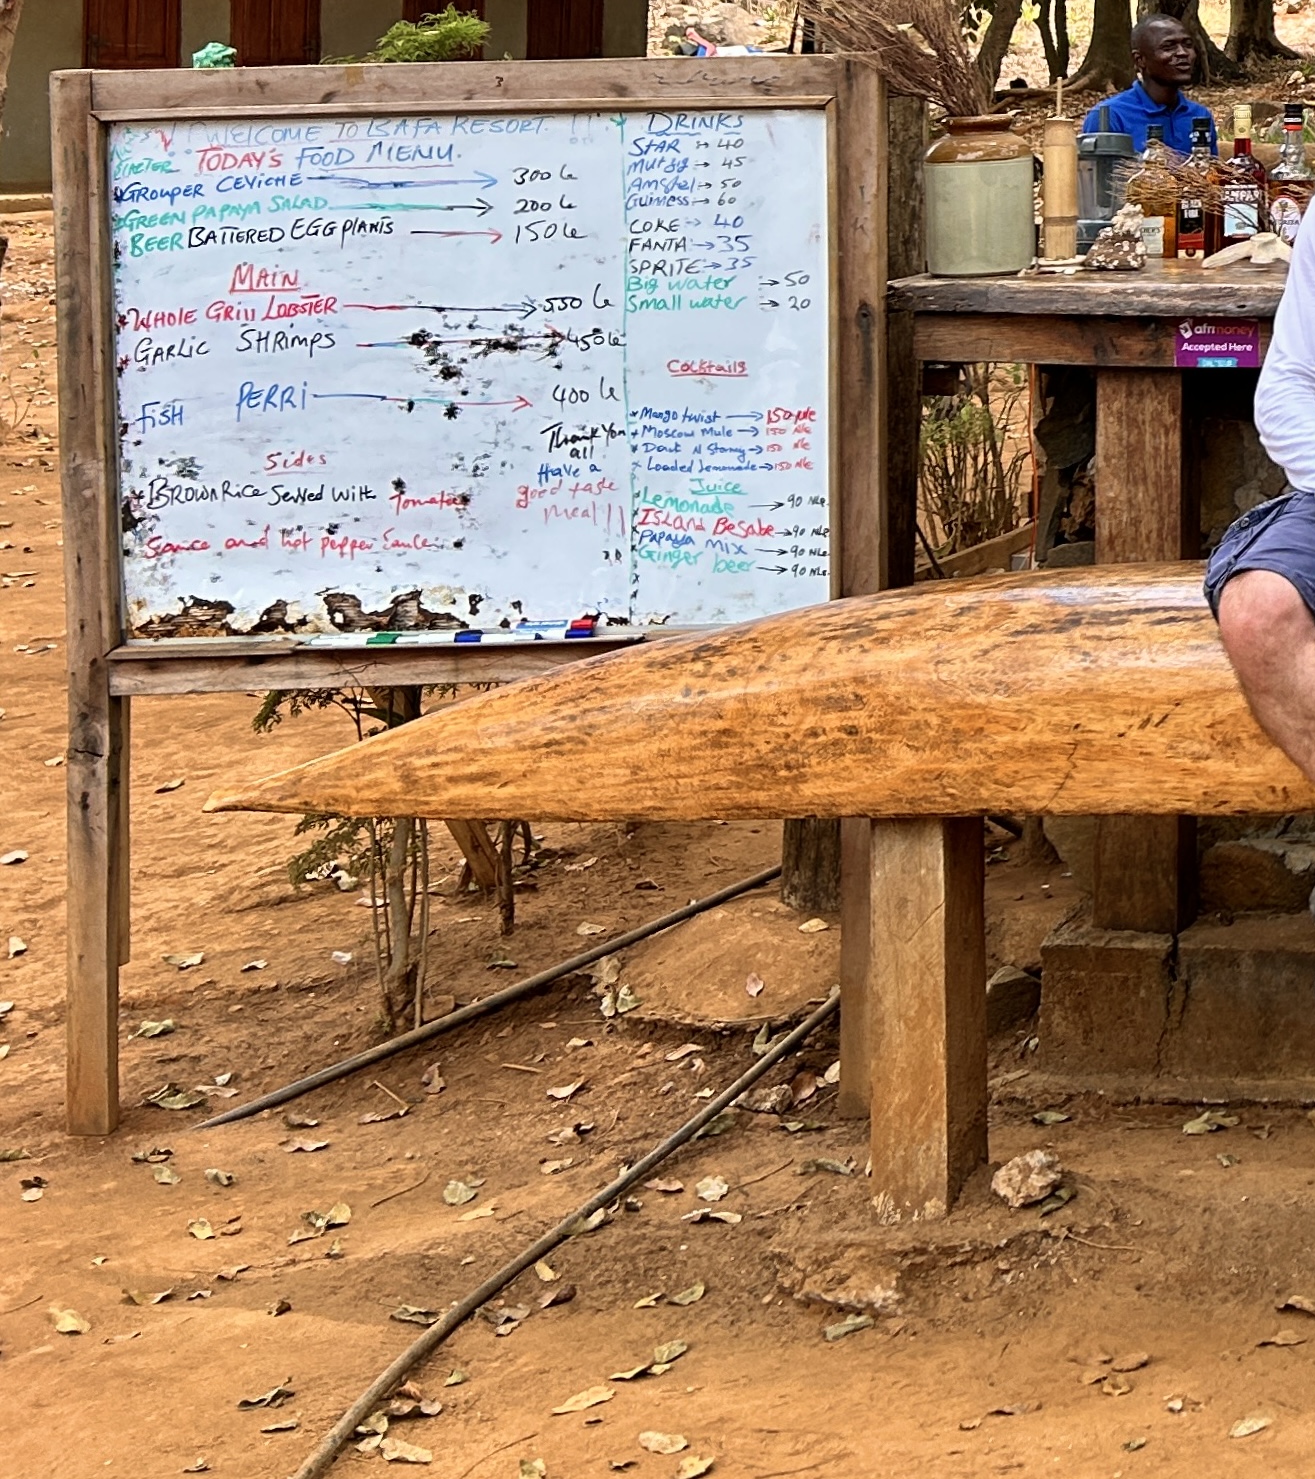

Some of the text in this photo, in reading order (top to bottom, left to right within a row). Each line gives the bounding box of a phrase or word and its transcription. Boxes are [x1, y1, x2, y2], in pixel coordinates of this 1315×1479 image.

[334, 122, 358, 139] TO
[647, 112, 745, 133] DRINKS
[716, 138, 745, 150] 40
[296, 147, 356, 167] FOOD
[721, 155, 748, 169] 45
[513, 167, 551, 186] 300
[720, 178, 742, 189] 50
[717, 192, 737, 206] 60
[122, 209, 186, 232] GREEN
[267, 195, 329, 212] SALAD
[513, 198, 551, 215] 200
[629, 214, 745, 235] COKE 40
[129, 231, 184, 258] BEER
[187, 225, 285, 249] BATTERED
[515, 219, 558, 244] 150
[628, 234, 754, 254] FANTA 35
[628, 256, 758, 277] SPRITE 35
[626, 270, 811, 294] Big water 50
[261, 294, 338, 322] LOBSTER
[541, 296, 582, 314] 550
[625, 294, 812, 314] Small water 20
[566, 329, 605, 352] 450
[1194, 323, 1256, 339] afrimoney
[1181, 342, 1254, 353] Accepted Here
[552, 384, 590, 412] 400
[639, 406, 678, 424] Mango
[766, 407, 792, 424] 150
[540, 422, 601, 454] Thank
[640, 424, 695, 439] Moscow
[701, 425, 734, 438] Mule
[263, 450, 327, 471] Sides
[569, 445, 594, 460] all
[647, 455, 694, 472] Loaded
[537, 463, 580, 486] Have
[690, 476, 743, 494] Juice
[516, 478, 563, 509] good
[640, 485, 735, 516] Lemonade
[786, 494, 802, 508] 90
[224, 524, 270, 550] and
[281, 528, 313, 550] hot
[320, 534, 374, 561] pepper
[639, 529, 696, 547] Papaya
[790, 546, 806, 560] 90
[637, 545, 703, 569] Ginger
[713, 553, 757, 573] beer
[791, 563, 807, 576] 90
